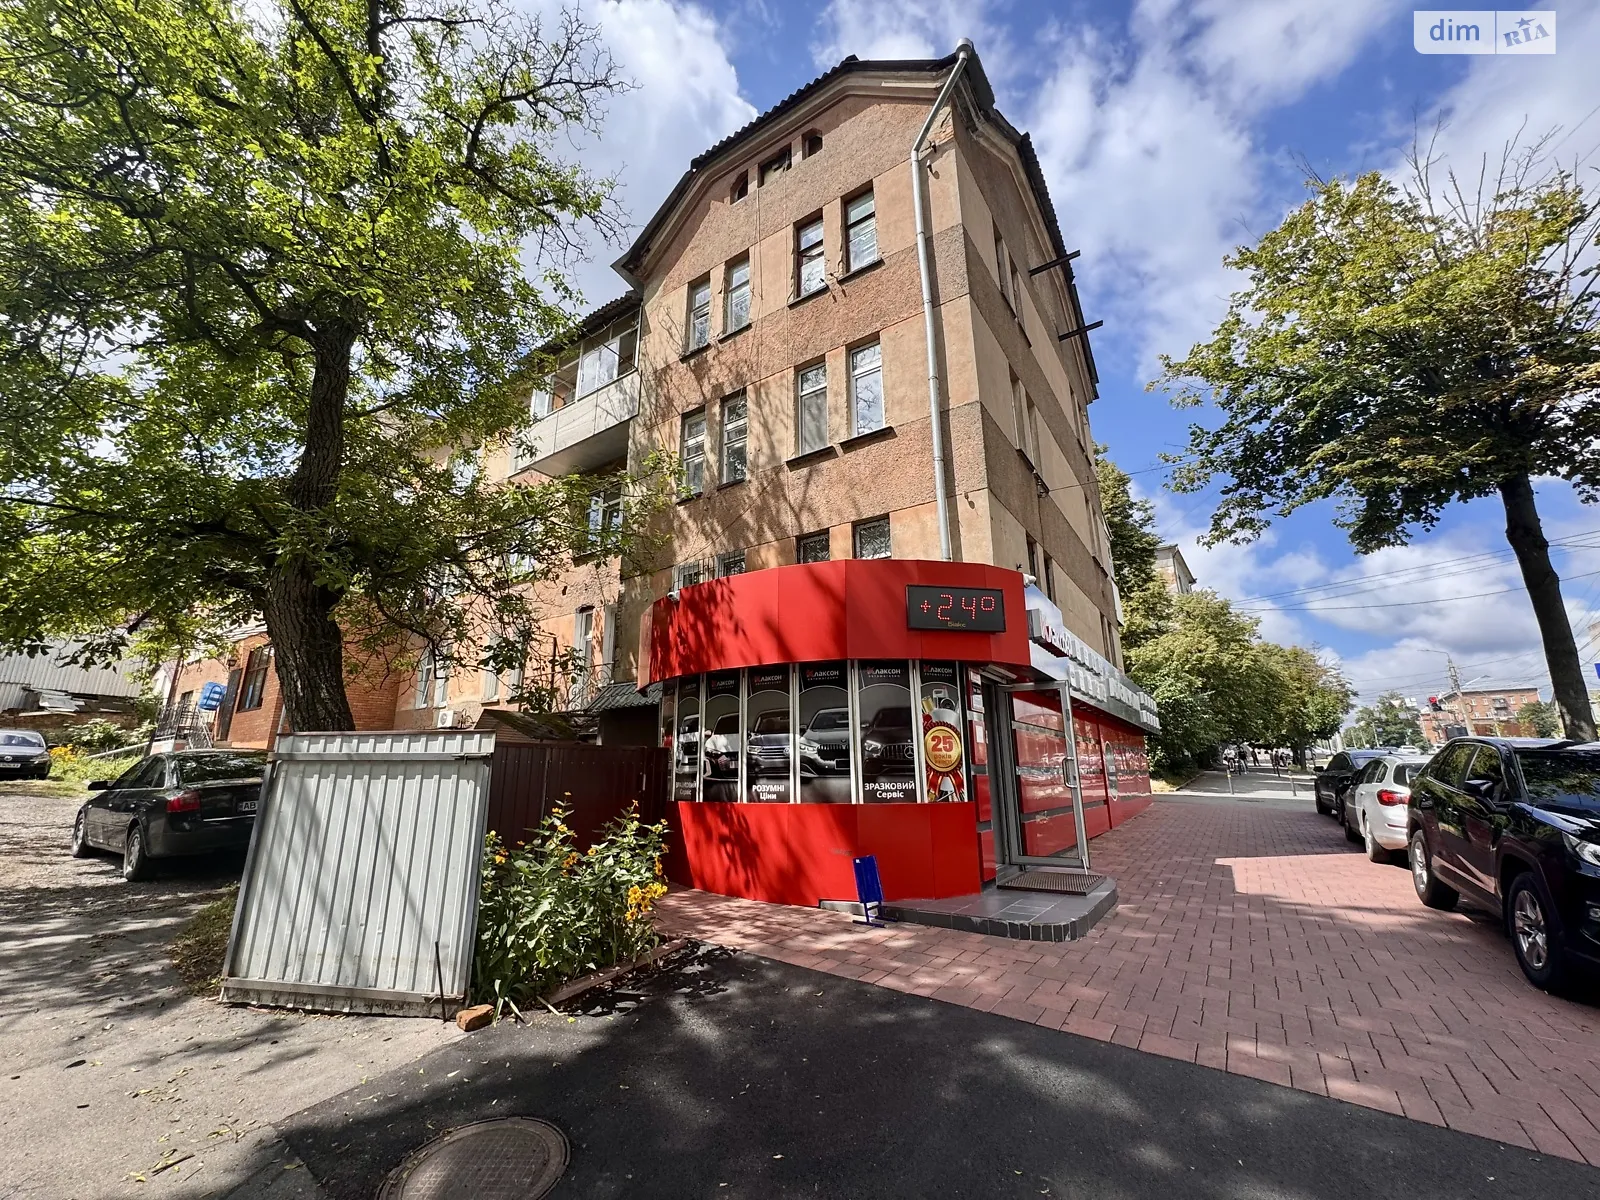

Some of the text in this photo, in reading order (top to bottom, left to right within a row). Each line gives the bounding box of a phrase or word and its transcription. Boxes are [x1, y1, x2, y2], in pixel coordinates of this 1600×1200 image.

[867, 666, 901, 675] Клаксон
[923, 664, 952, 673] Клаксон
[806, 669, 839, 678] Клаксон
[754, 674, 782, 683] Клаксон
[930, 735, 954, 753] 25
[752, 784, 785, 793] РОЗУМНІ
[864, 780, 915, 791] ЗРАЗКОВИЙ
[759, 792, 777, 801] Ціни
[876, 790, 905, 800] Сервіс
